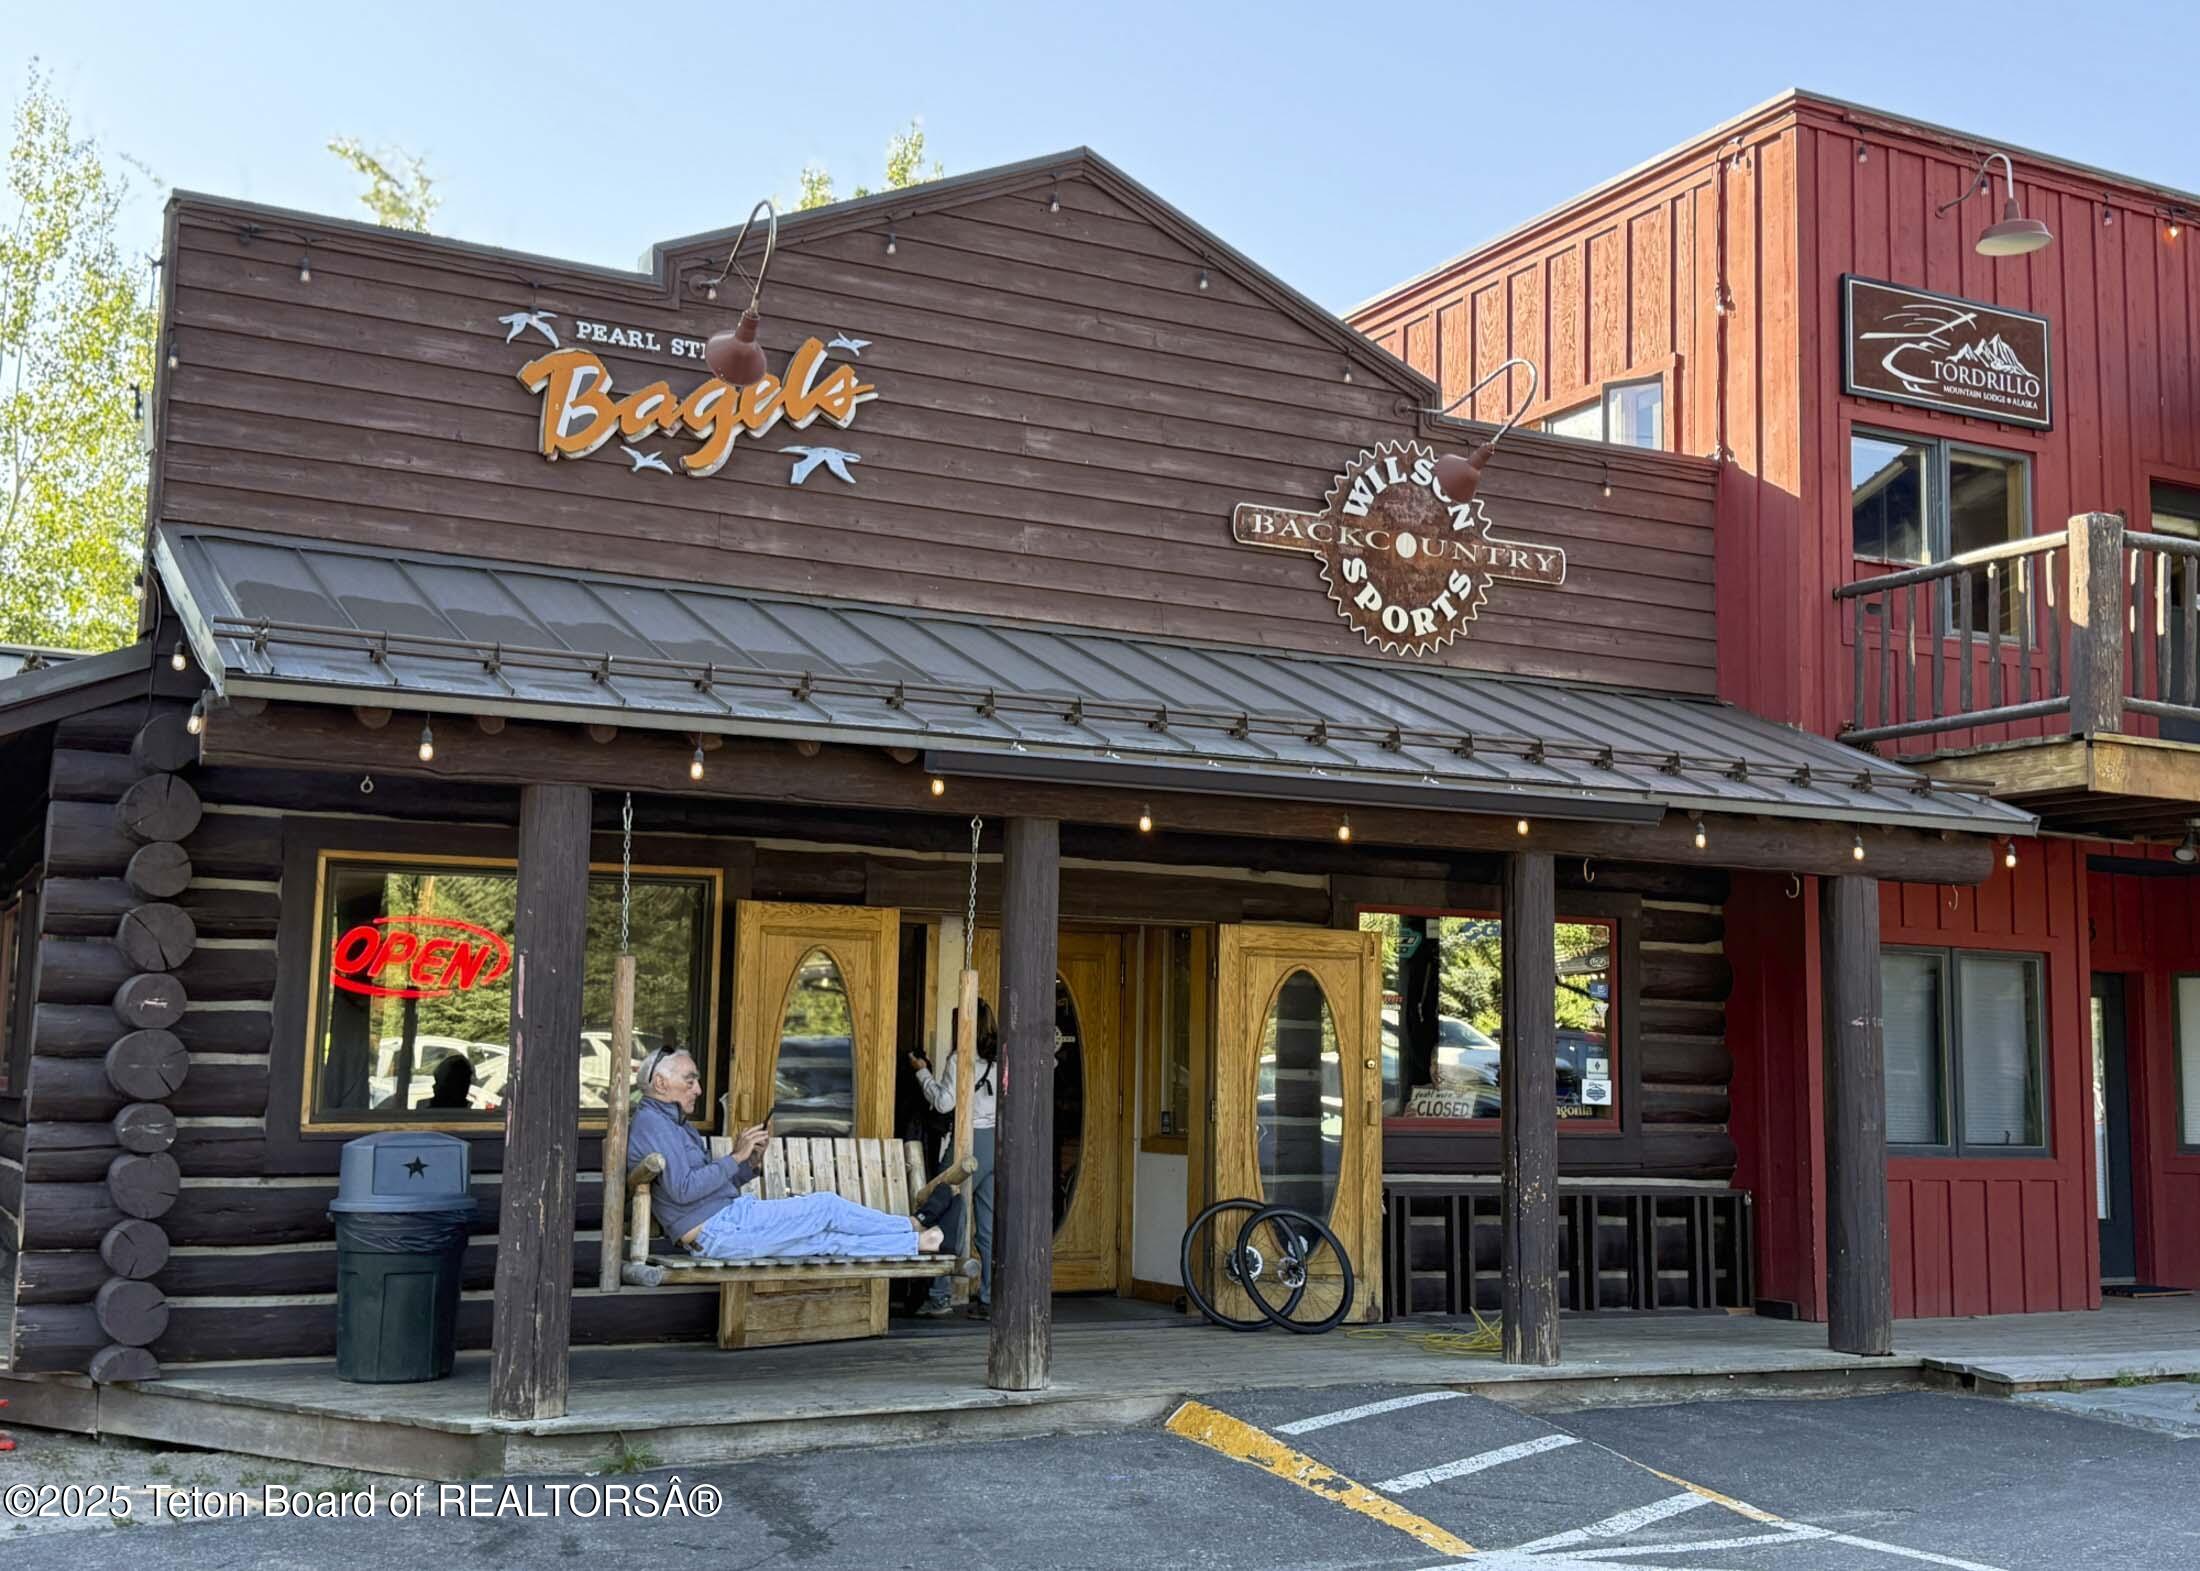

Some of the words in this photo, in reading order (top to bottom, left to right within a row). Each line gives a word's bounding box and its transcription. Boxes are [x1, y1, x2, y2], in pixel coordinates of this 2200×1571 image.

[575, 320, 661, 353] PEARL
[1930, 359, 2040, 398] TORDRILLO
[1943, 385, 1982, 399] MOUNTAIN
[1983, 391, 2006, 404] LODGE
[2012, 397, 2039, 410] ALASKA
[515, 336, 879, 479] Bagels
[1251, 513, 1558, 573] BACKCOUNTRY
[1342, 556, 1472, 637] SPORTS
[332, 924, 492, 991] OPEN
[1416, 1100, 1470, 1117] CLOSED
